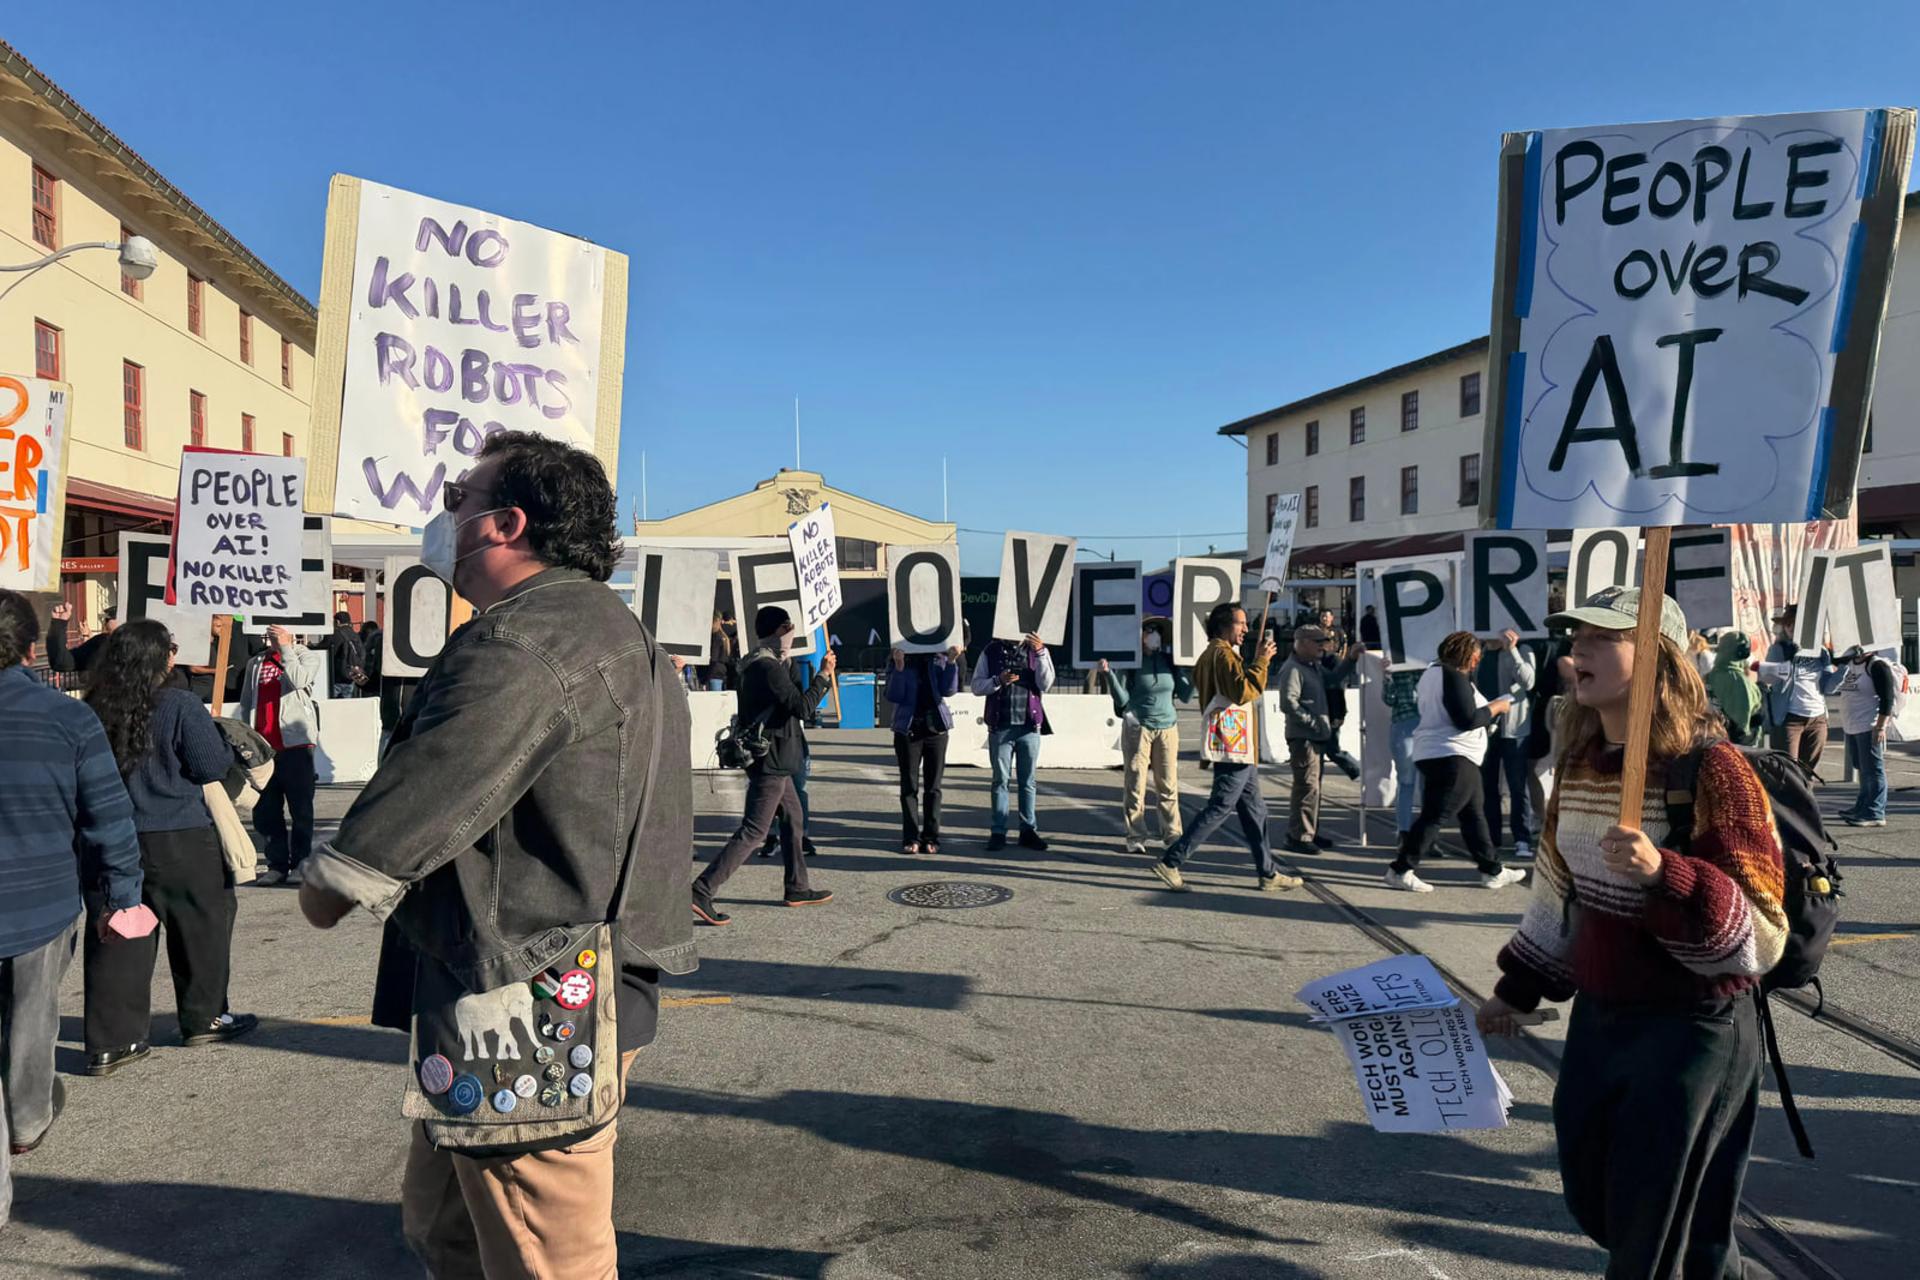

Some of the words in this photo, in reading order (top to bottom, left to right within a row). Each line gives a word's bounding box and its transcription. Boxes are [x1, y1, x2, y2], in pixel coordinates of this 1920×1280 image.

[1555, 137, 1844, 226] PEOPLE
[415, 217, 510, 268] NO
[368, 256, 580, 348] KILLER
[374, 331, 572, 419] ROBOTS
[1548, 327, 1724, 479] AI
[190, 468, 297, 508] PEOPLE
[206, 512, 267, 530] OVER
[803, 521, 819, 544] NO
[211, 534, 270, 556] AI!
[799, 538, 831, 574] KILLER
[183, 561, 215, 578] NO
[219, 563, 292, 586] KILLER
[803, 551, 834, 587] ROBOTS
[814, 576, 830, 597] FOR
[190, 581, 289, 609] ROBOTS
[1322, 990, 1349, 1014] ERS
[1368, 1018, 1393, 1058] ORG
[1462, 1033, 1475, 1052] BAY
[1362, 1064, 1389, 1113] TECH
[1381, 1063, 1410, 1116] MUST
[1427, 1071, 1468, 1126] TECH
[1460, 1070, 1475, 1097] TECH
